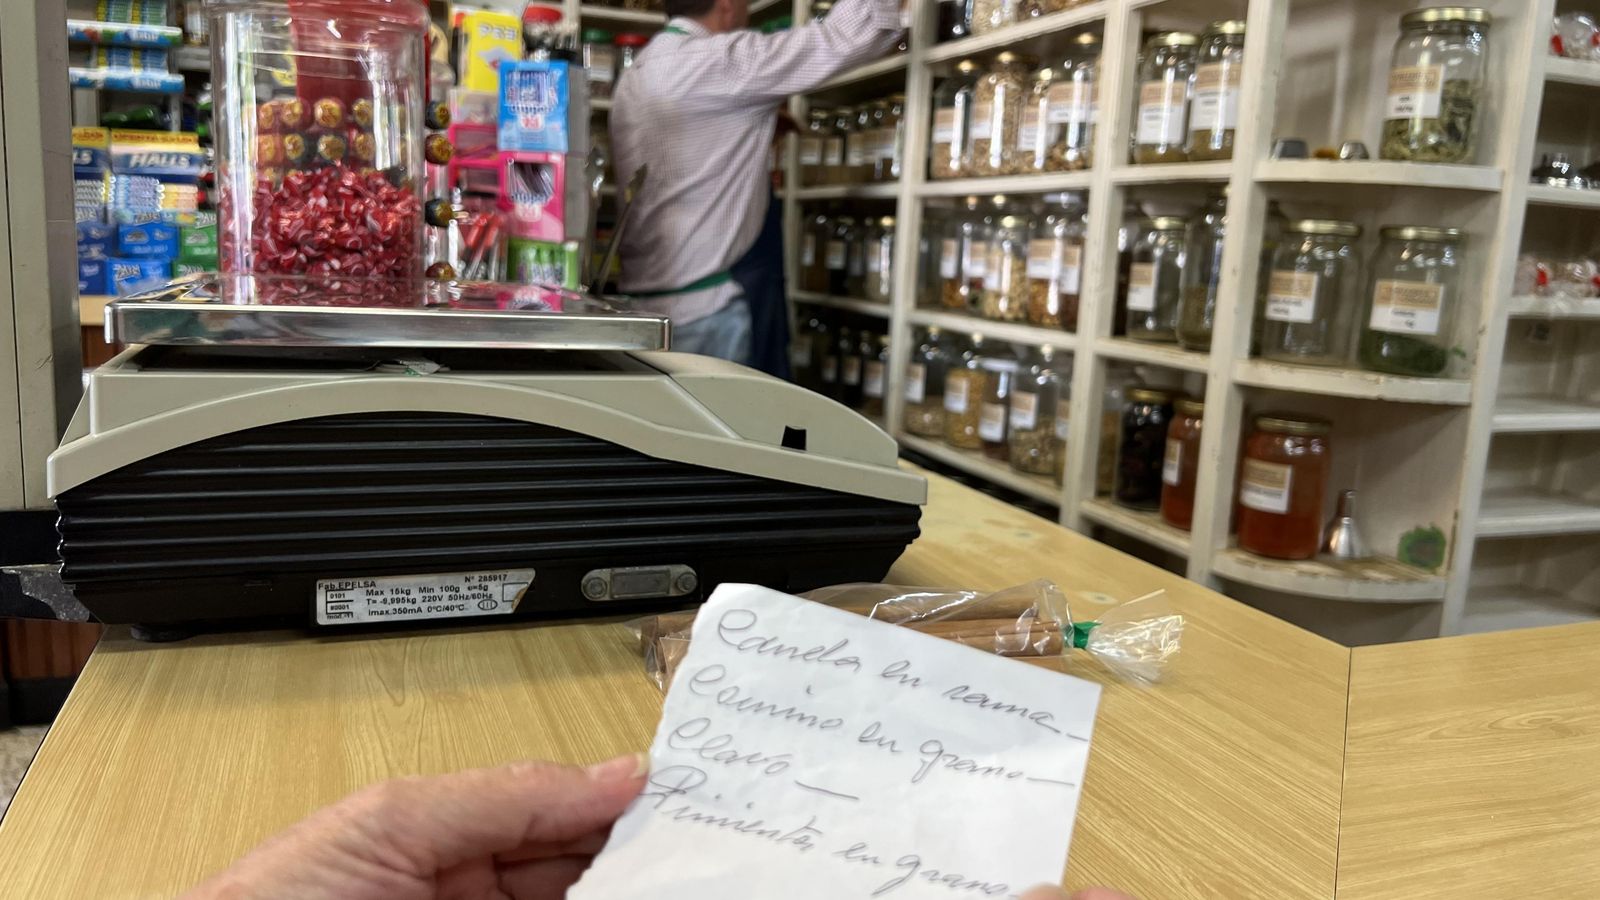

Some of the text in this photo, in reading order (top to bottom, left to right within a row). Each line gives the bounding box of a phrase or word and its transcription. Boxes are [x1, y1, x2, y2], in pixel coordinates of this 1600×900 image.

[129, 152, 191, 168] HALLS
[365, 589, 384, 597] Max
[418, 586, 435, 594] Min
[440, 585, 460, 593] 100g
[421, 595, 443, 603] 220V
[717, 608, 861, 673] Canela
[881, 659, 921, 687] en
[668, 717, 793, 775] Clavo
[858, 721, 901, 753] en
